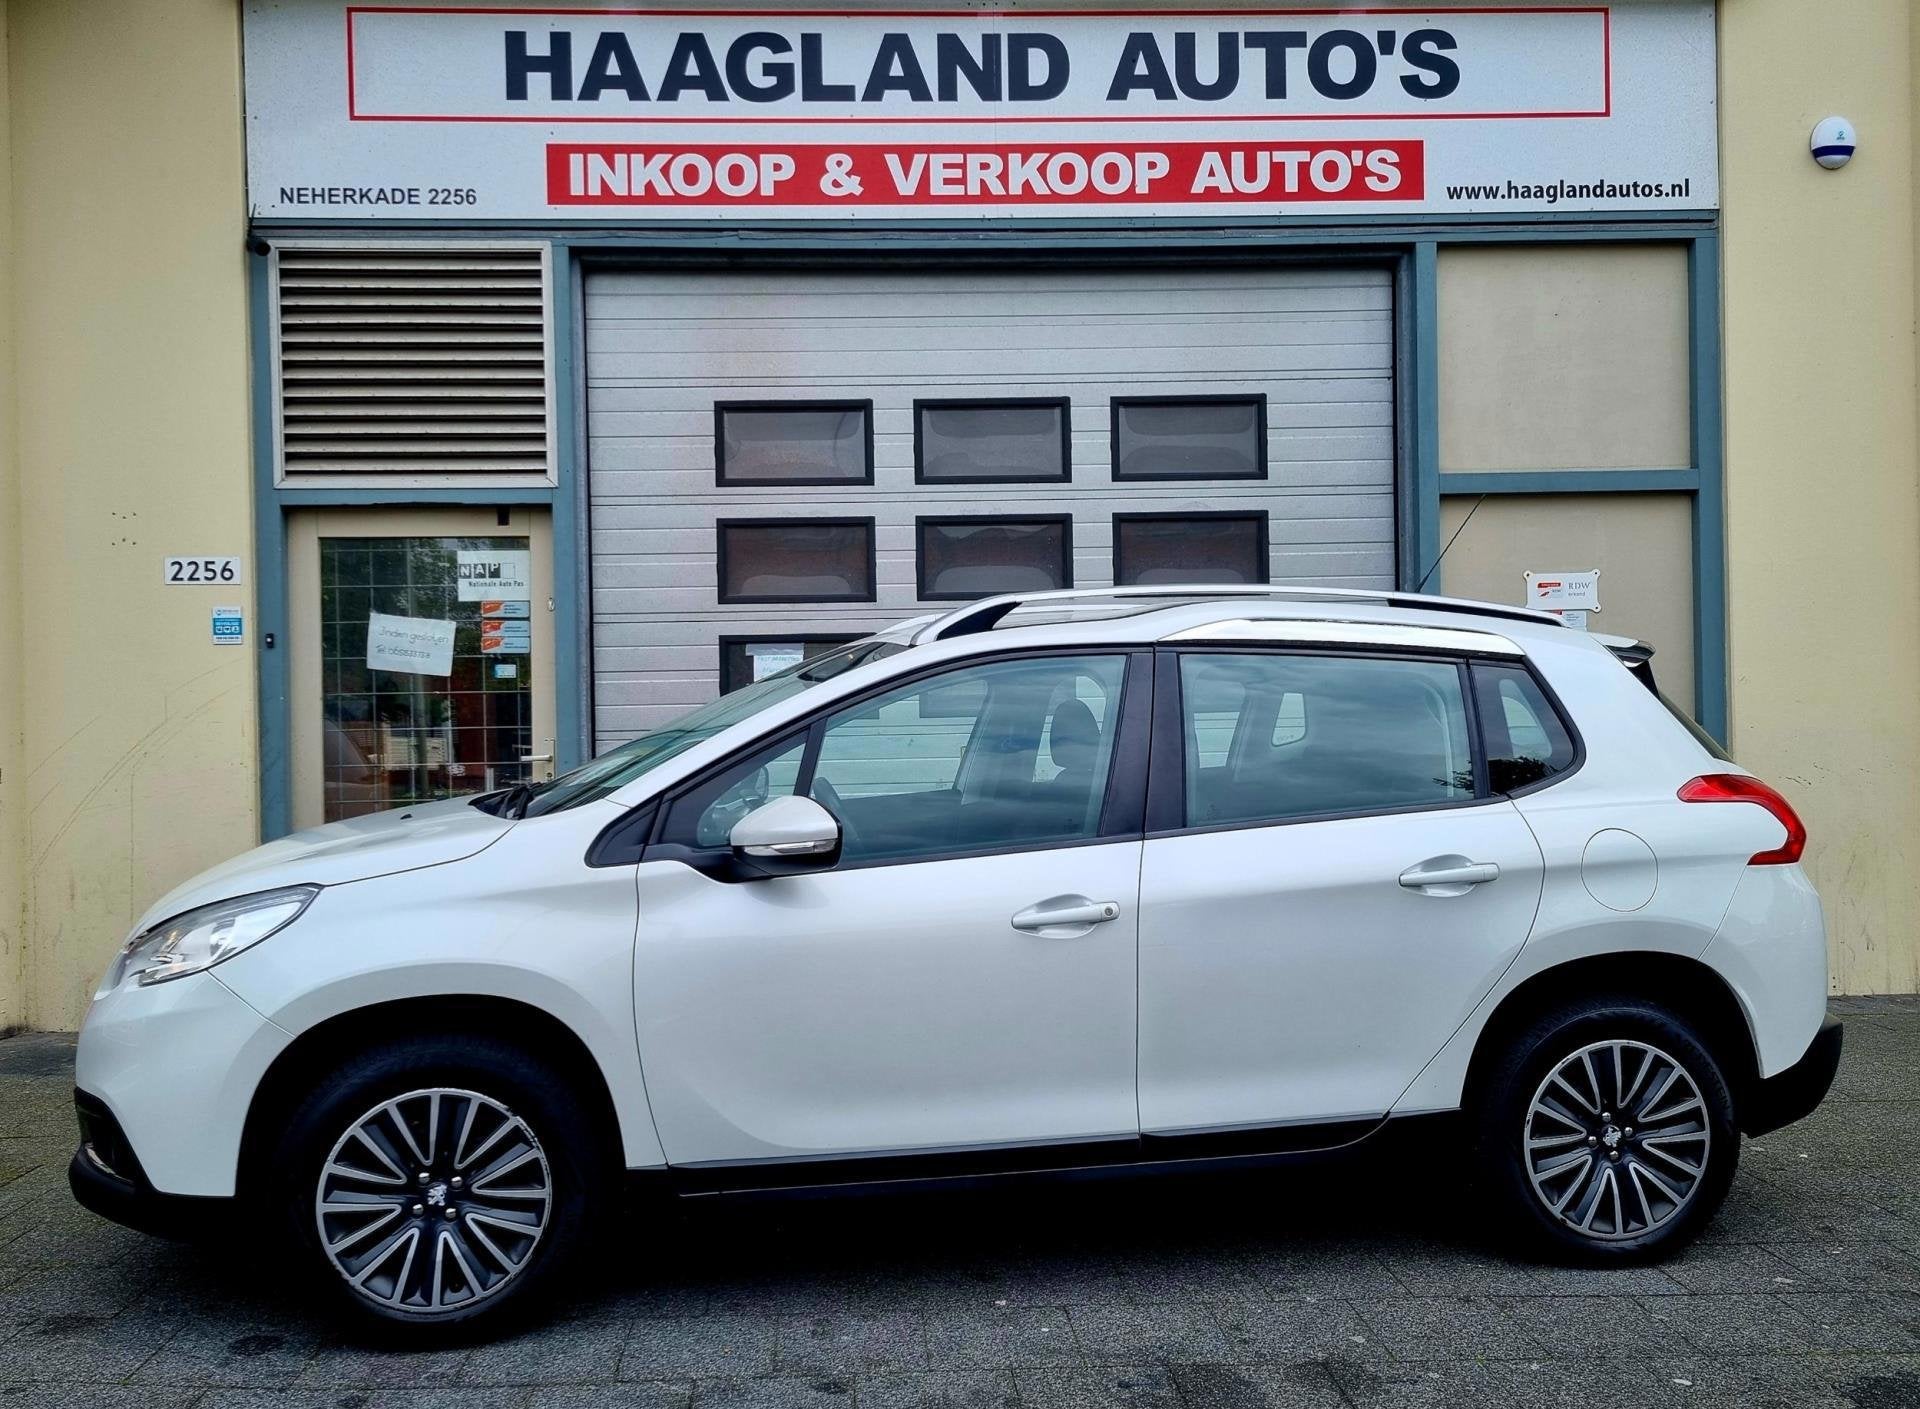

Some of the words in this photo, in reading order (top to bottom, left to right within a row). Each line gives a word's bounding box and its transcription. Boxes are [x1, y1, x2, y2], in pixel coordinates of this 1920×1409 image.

[505, 31, 1069, 102] HAAGLAND
[1106, 29, 1460, 101] AUTO'S
[570, 154, 795, 196] INKOOP
[820, 153, 864, 196] &
[884, 152, 1169, 195] VERKOOP
[1191, 150, 1401, 193] AUTO'S
[281, 188, 420, 204] NEHERKADE
[429, 189, 476, 205] 2256
[1447, 178, 1689, 203] www.haaglandautos.nl
[171, 561, 234, 581] 2256
[460, 563, 499, 576] NAP
